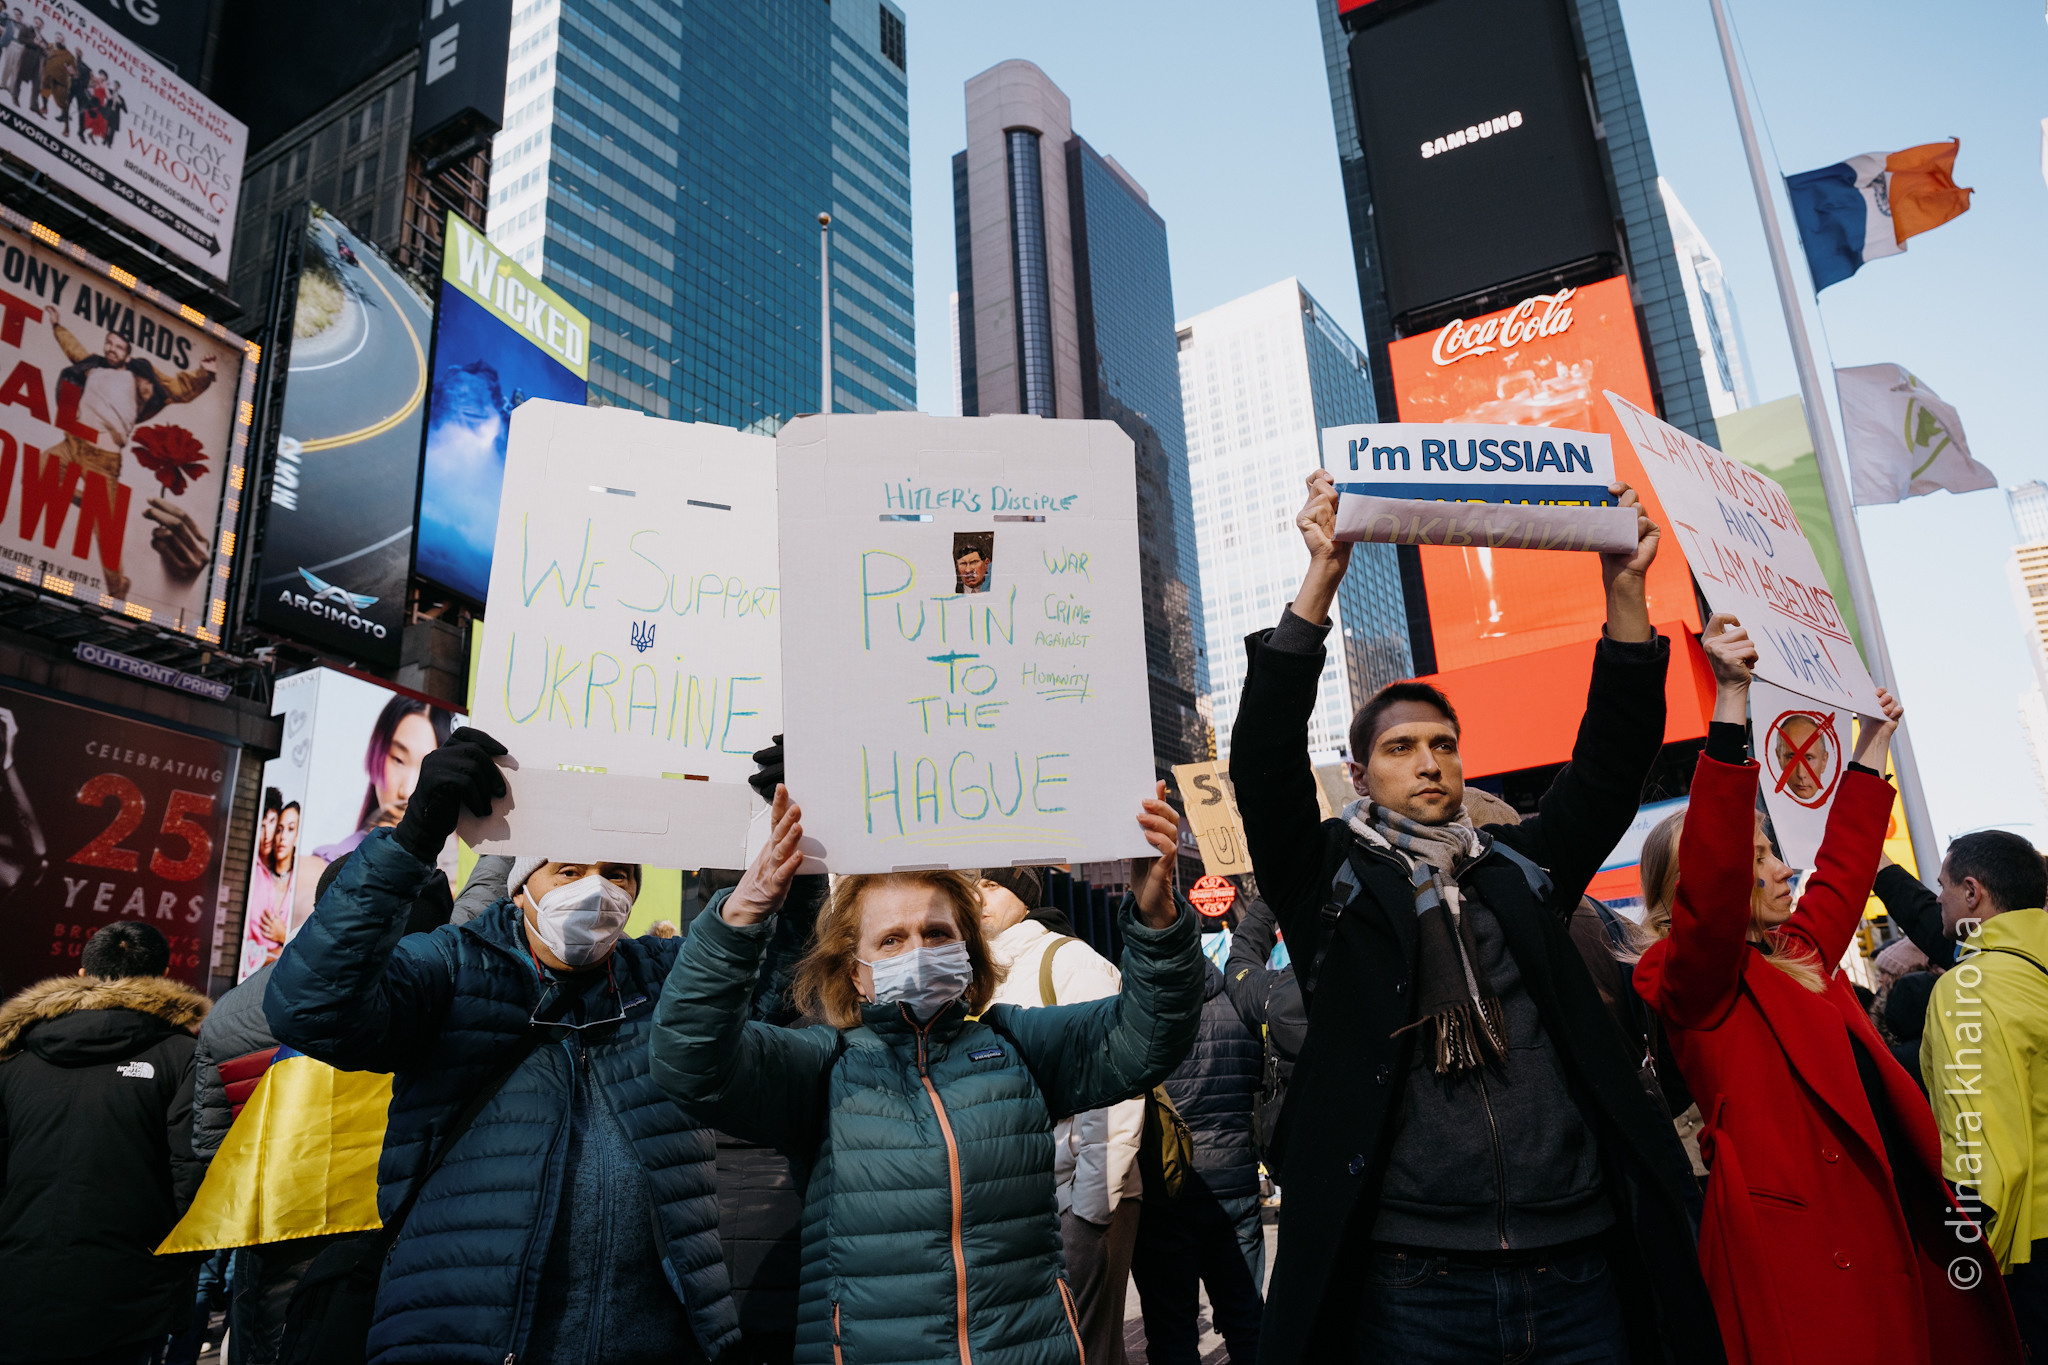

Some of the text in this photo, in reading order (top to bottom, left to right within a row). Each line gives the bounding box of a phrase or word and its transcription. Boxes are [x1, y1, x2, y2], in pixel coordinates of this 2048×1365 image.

[90, 25, 156, 78] FUNNIEST
[160, 75, 205, 112] SMASH
[207, 109, 230, 130] HIT
[140, 73, 233, 146] PHENOMENON
[130, 110, 232, 192] THAT GOES
[142, 101, 228, 167] THE PLAY
[1420, 110, 1523, 160] SAMSUNG
[12, 116, 61, 153] WORLD
[60, 147, 107, 183] STAGES
[111, 180, 136, 201] 340
[174, 218, 214, 248] STREET
[127, 127, 230, 216] WRONG
[73, 282, 193, 371] AWARDS
[1432, 287, 1578, 367] Coca-Cola
[1348, 437, 1594, 474] I'm RUSSIAN
[1658, 426, 1705, 482] AM
[1695, 442, 1807, 540] RUSSIAN
[1042, 545, 1093, 583] WAR
[1714, 496, 1775, 559] AND
[616, 528, 781, 621] SUPPORT
[860, 548, 1018, 654] PUTIN
[1711, 536, 1760, 598] AM
[1751, 555, 1847, 634] AGAINST
[278, 589, 388, 640] ARCIMOTO
[1034, 631, 1093, 649] AGAINST
[82, 646, 226, 699] OUTFRONT PRIME
[926, 649, 998, 696] TO
[906, 695, 1010, 737] THE
[84, 740, 224, 785] CELEBRATING
[860, 743, 1072, 838] HAGUE
[66, 772, 217, 882] 25
[63, 875, 205, 924] YEARS
